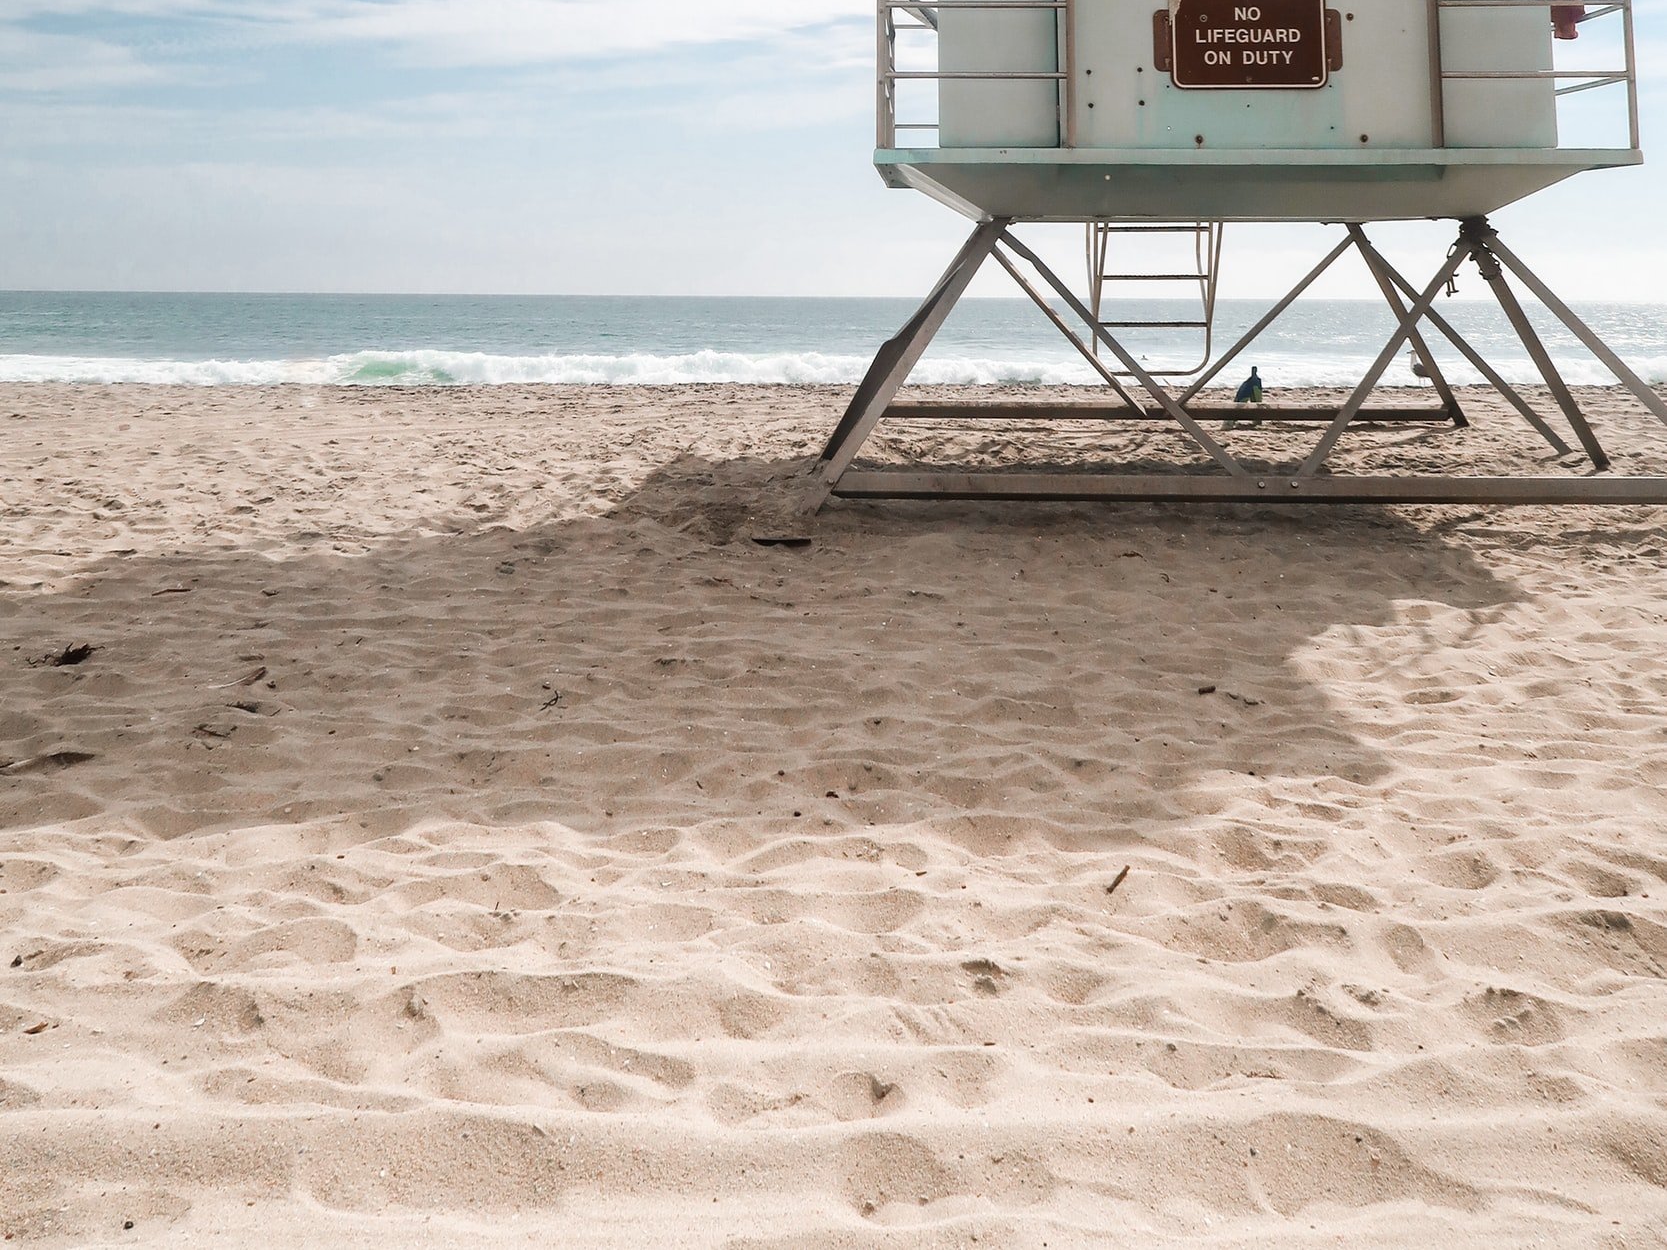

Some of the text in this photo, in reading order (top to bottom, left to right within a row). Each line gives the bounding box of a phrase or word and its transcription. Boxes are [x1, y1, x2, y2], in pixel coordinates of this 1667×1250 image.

[1234, 6, 1262, 21] NO
[1195, 28, 1301, 43] LIFEGUARD
[1204, 50, 1294, 65] ON DUTY
